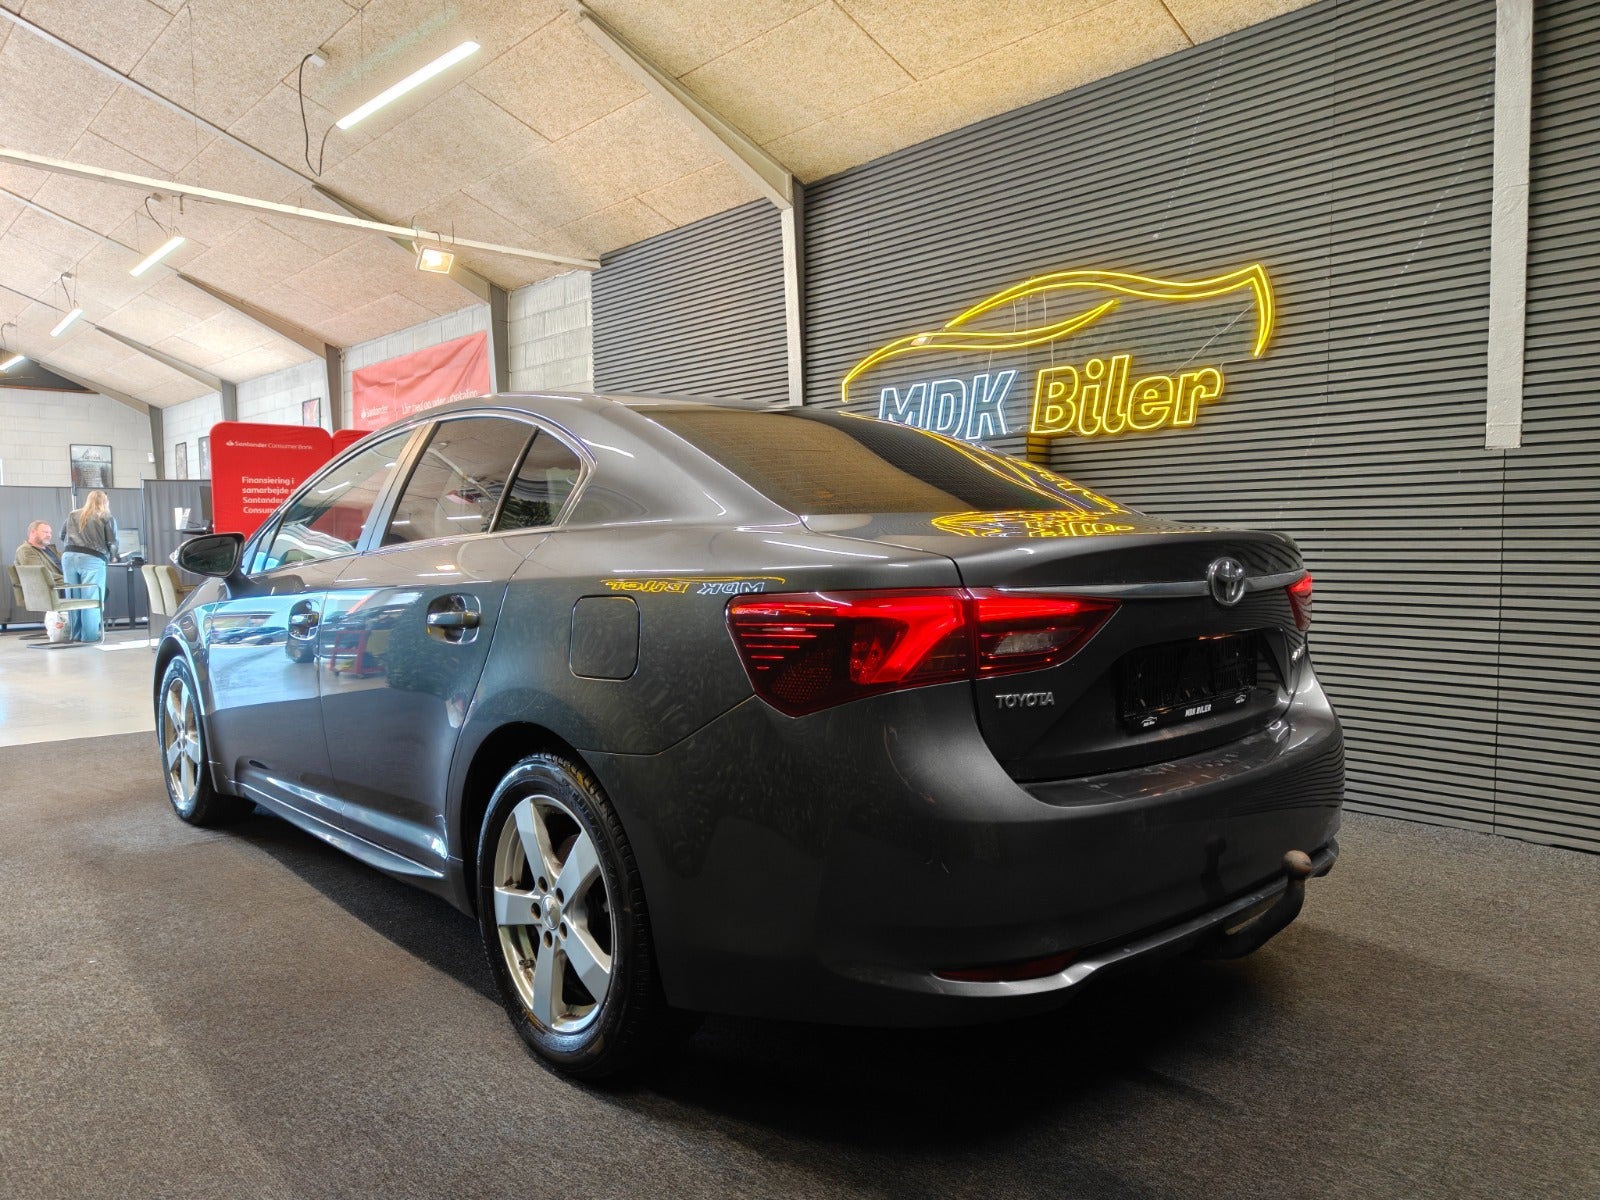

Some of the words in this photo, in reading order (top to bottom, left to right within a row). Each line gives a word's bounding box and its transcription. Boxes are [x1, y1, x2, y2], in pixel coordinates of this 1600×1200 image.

[877, 368, 1017, 440] MDK
[1030, 353, 1226, 437] Biler
[234, 441, 266, 449] Santander
[268, 442, 297, 450] Consumer
[241, 476, 290, 486] Finansiering
[242, 486, 289, 495] samarbejde
[243, 506, 275, 514] Consum
[995, 691, 1055, 709] TOYOTA
